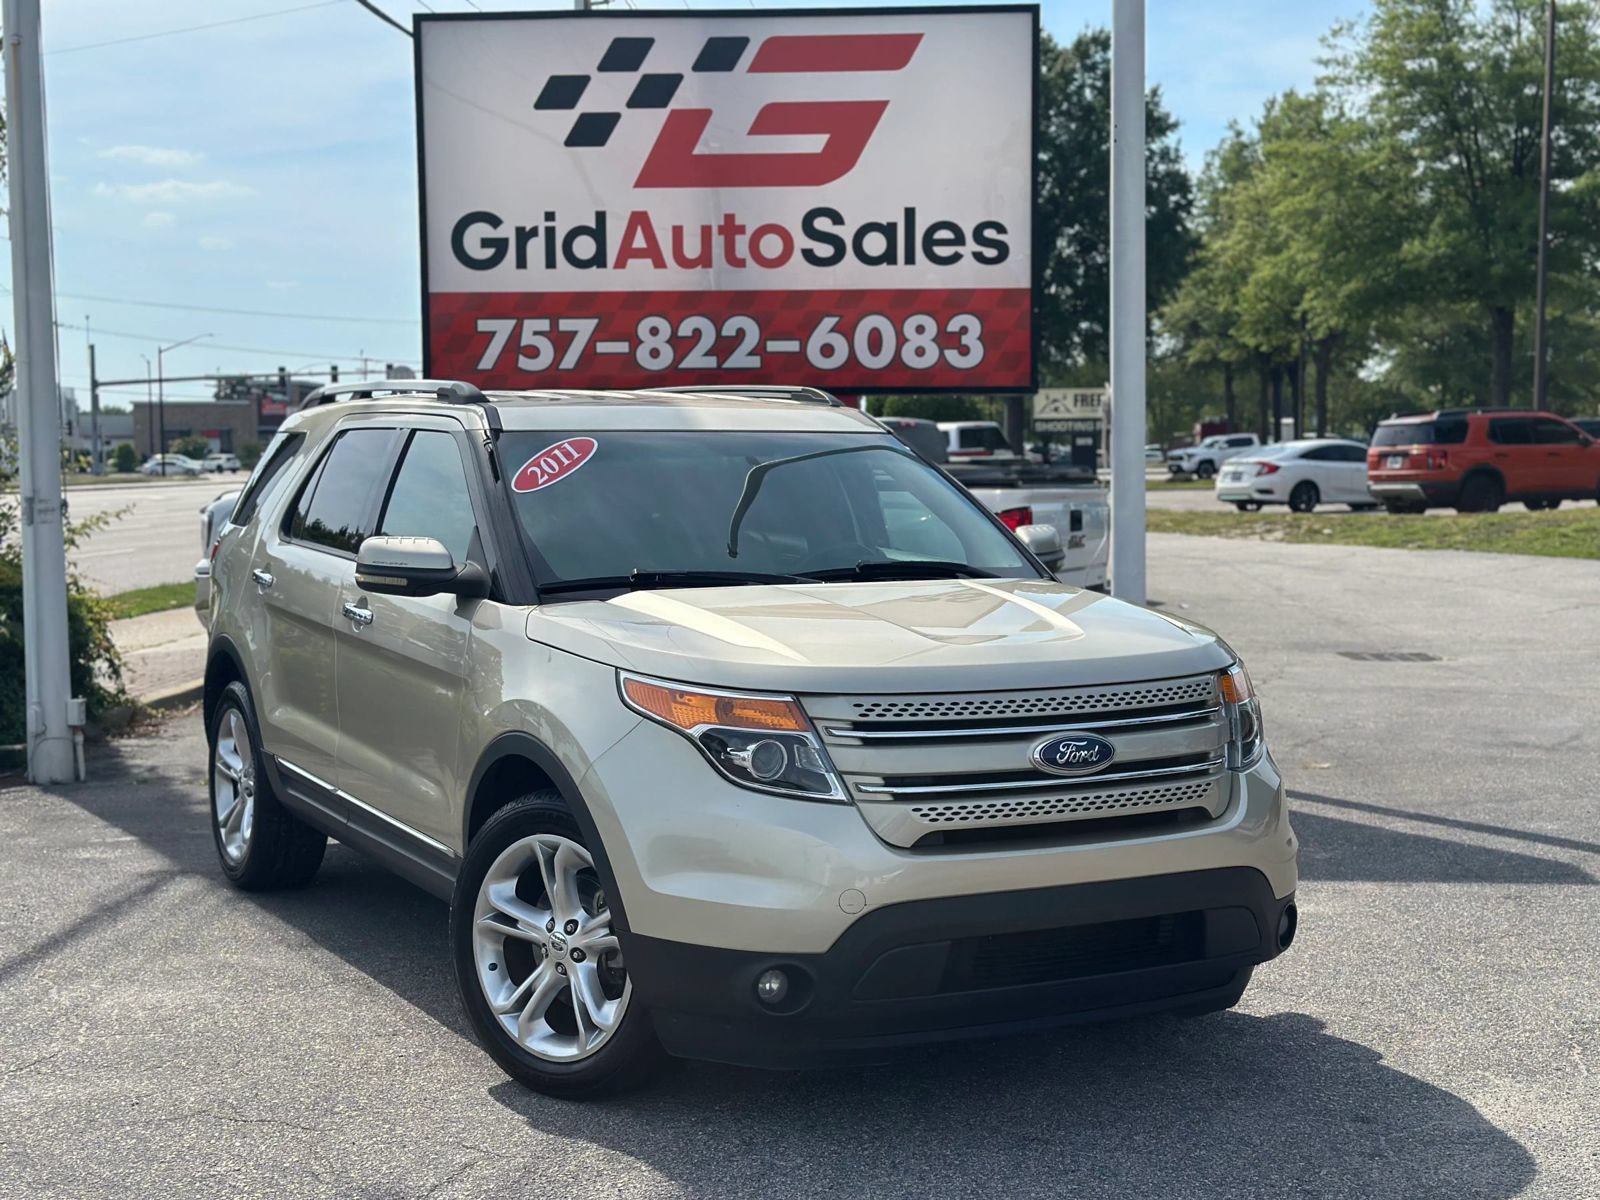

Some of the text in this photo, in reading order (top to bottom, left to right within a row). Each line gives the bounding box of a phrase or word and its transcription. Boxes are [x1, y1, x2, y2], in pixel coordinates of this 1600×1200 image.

[475, 314, 985, 372] 757-822-6083
[527, 442, 582, 485] 2011
[1056, 741, 1100, 765] Ford
